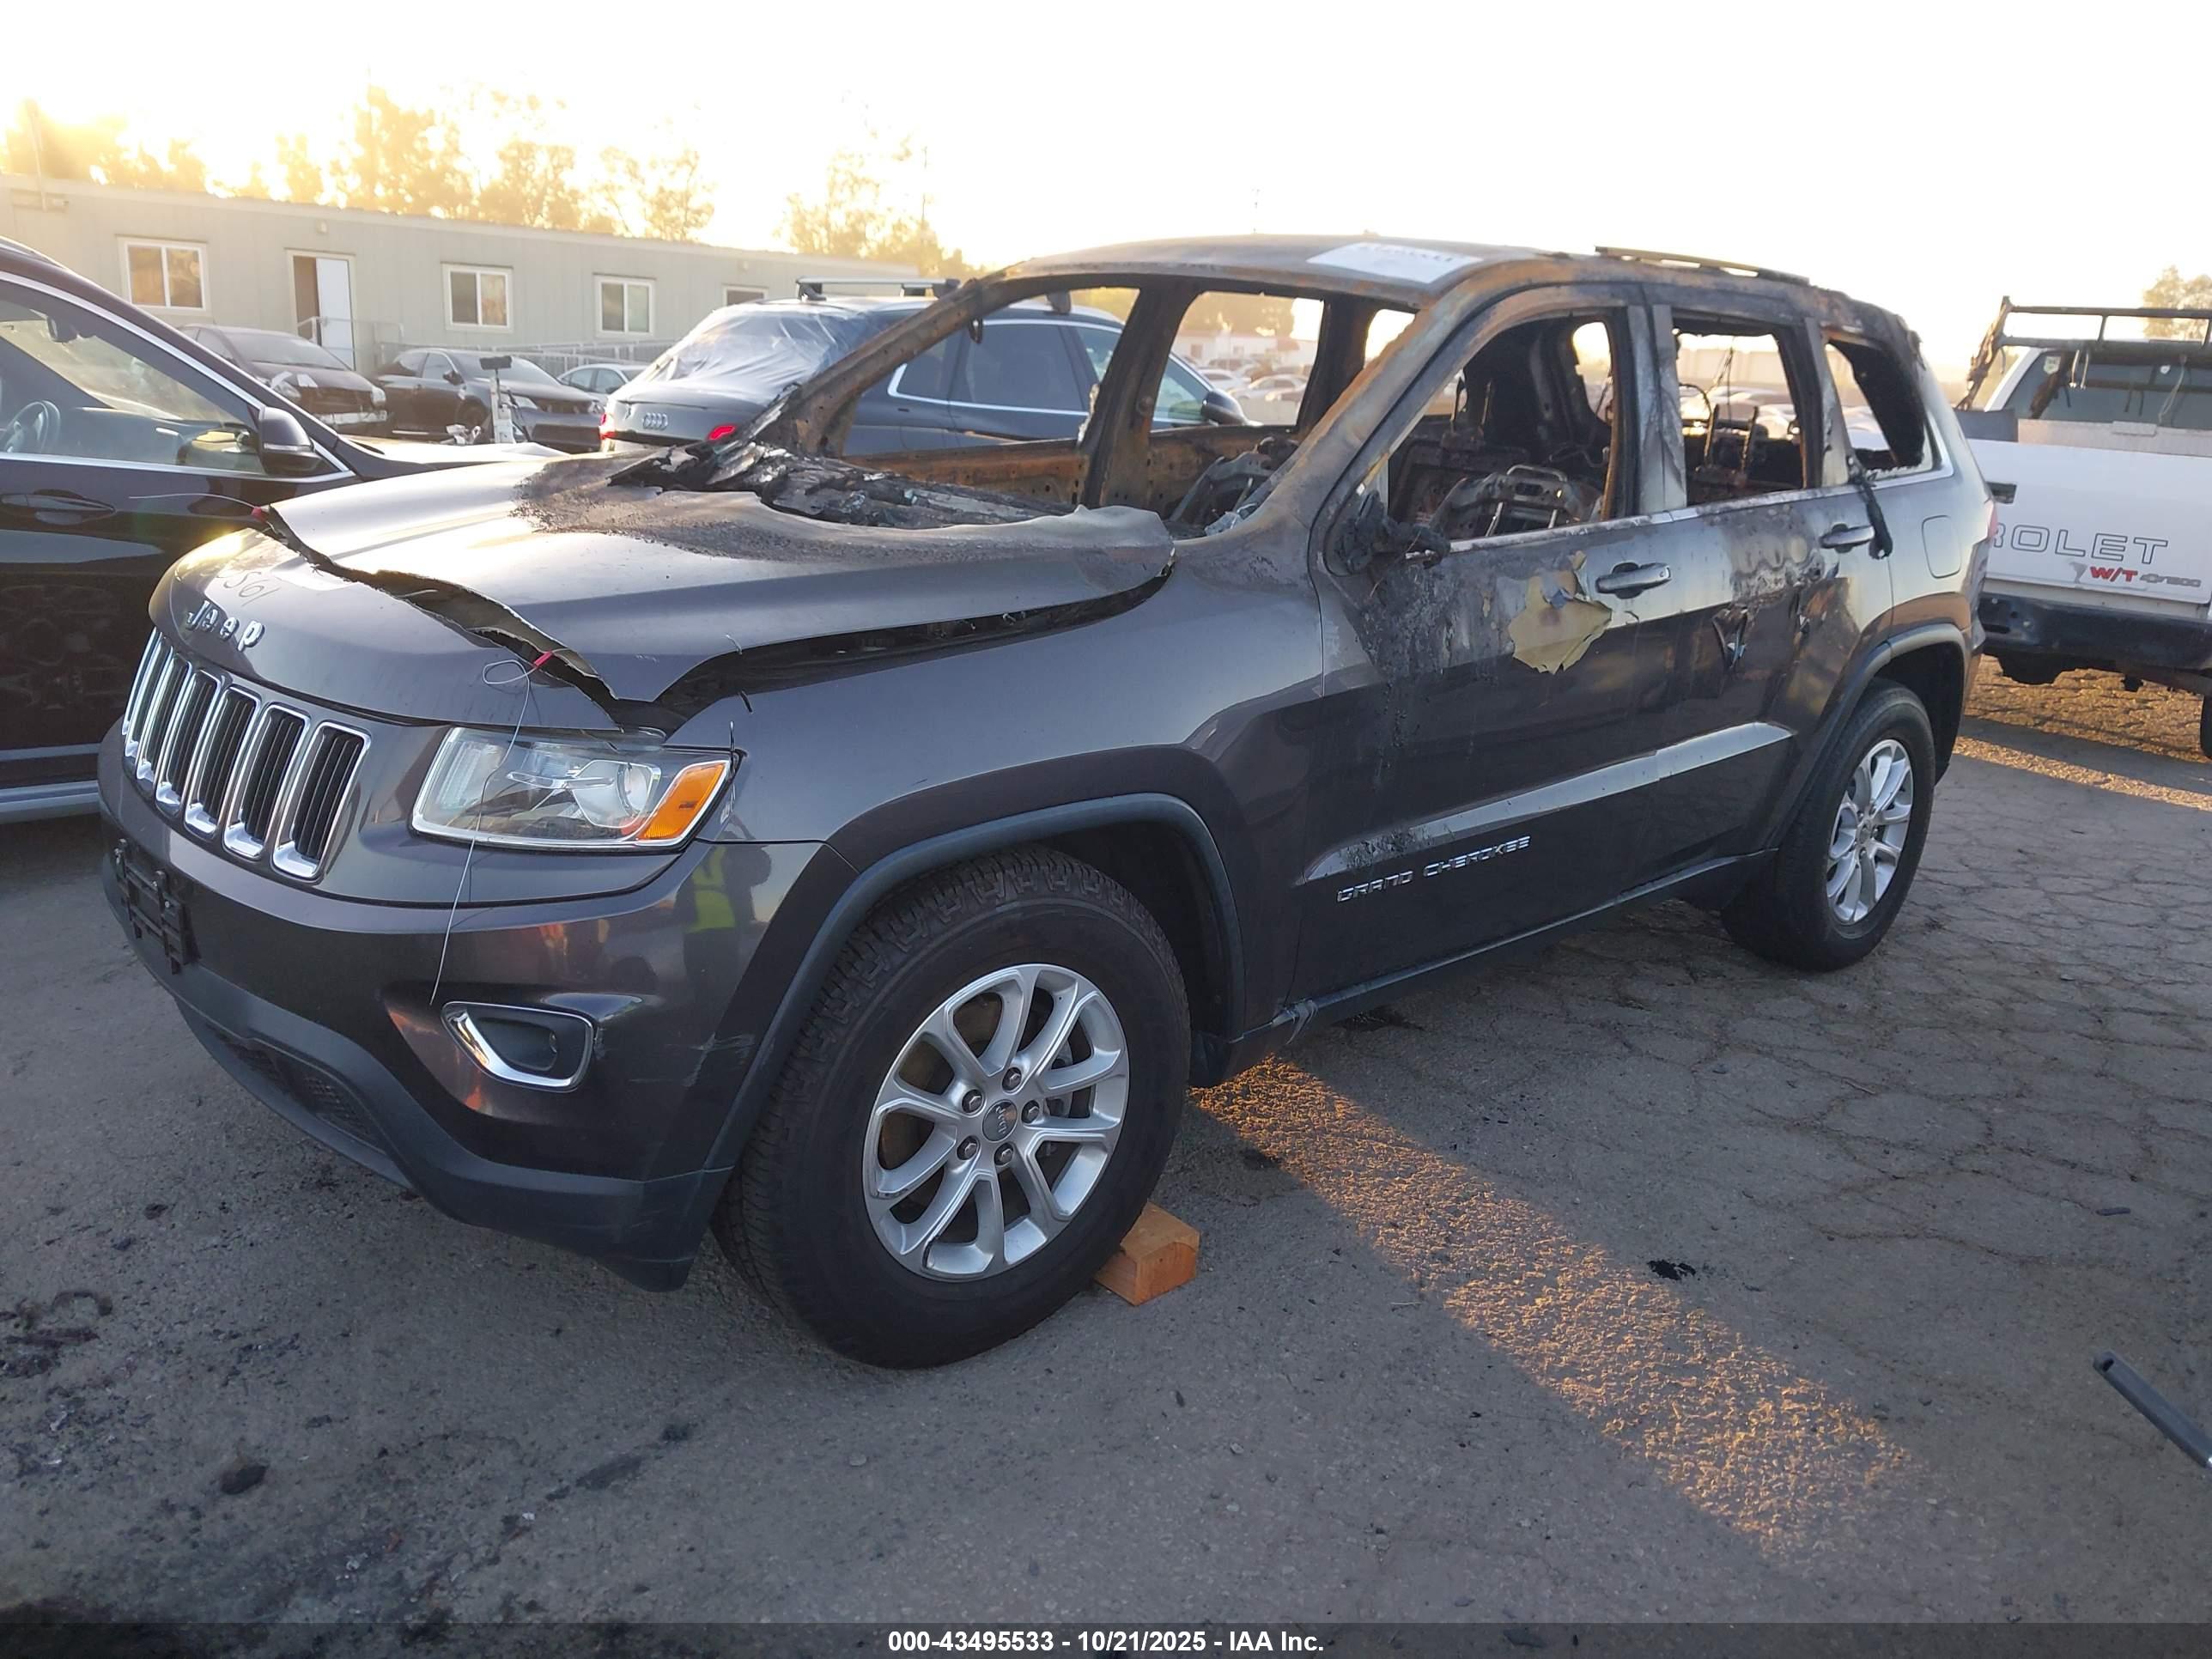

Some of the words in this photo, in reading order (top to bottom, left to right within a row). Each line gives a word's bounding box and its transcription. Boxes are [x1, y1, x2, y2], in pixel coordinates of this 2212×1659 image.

[2090, 566, 2138, 582] W/T
[186, 599, 264, 653] Jeep
[1337, 871, 1413, 902] GRAND
[1423, 836, 1531, 877] CHEROKEE
